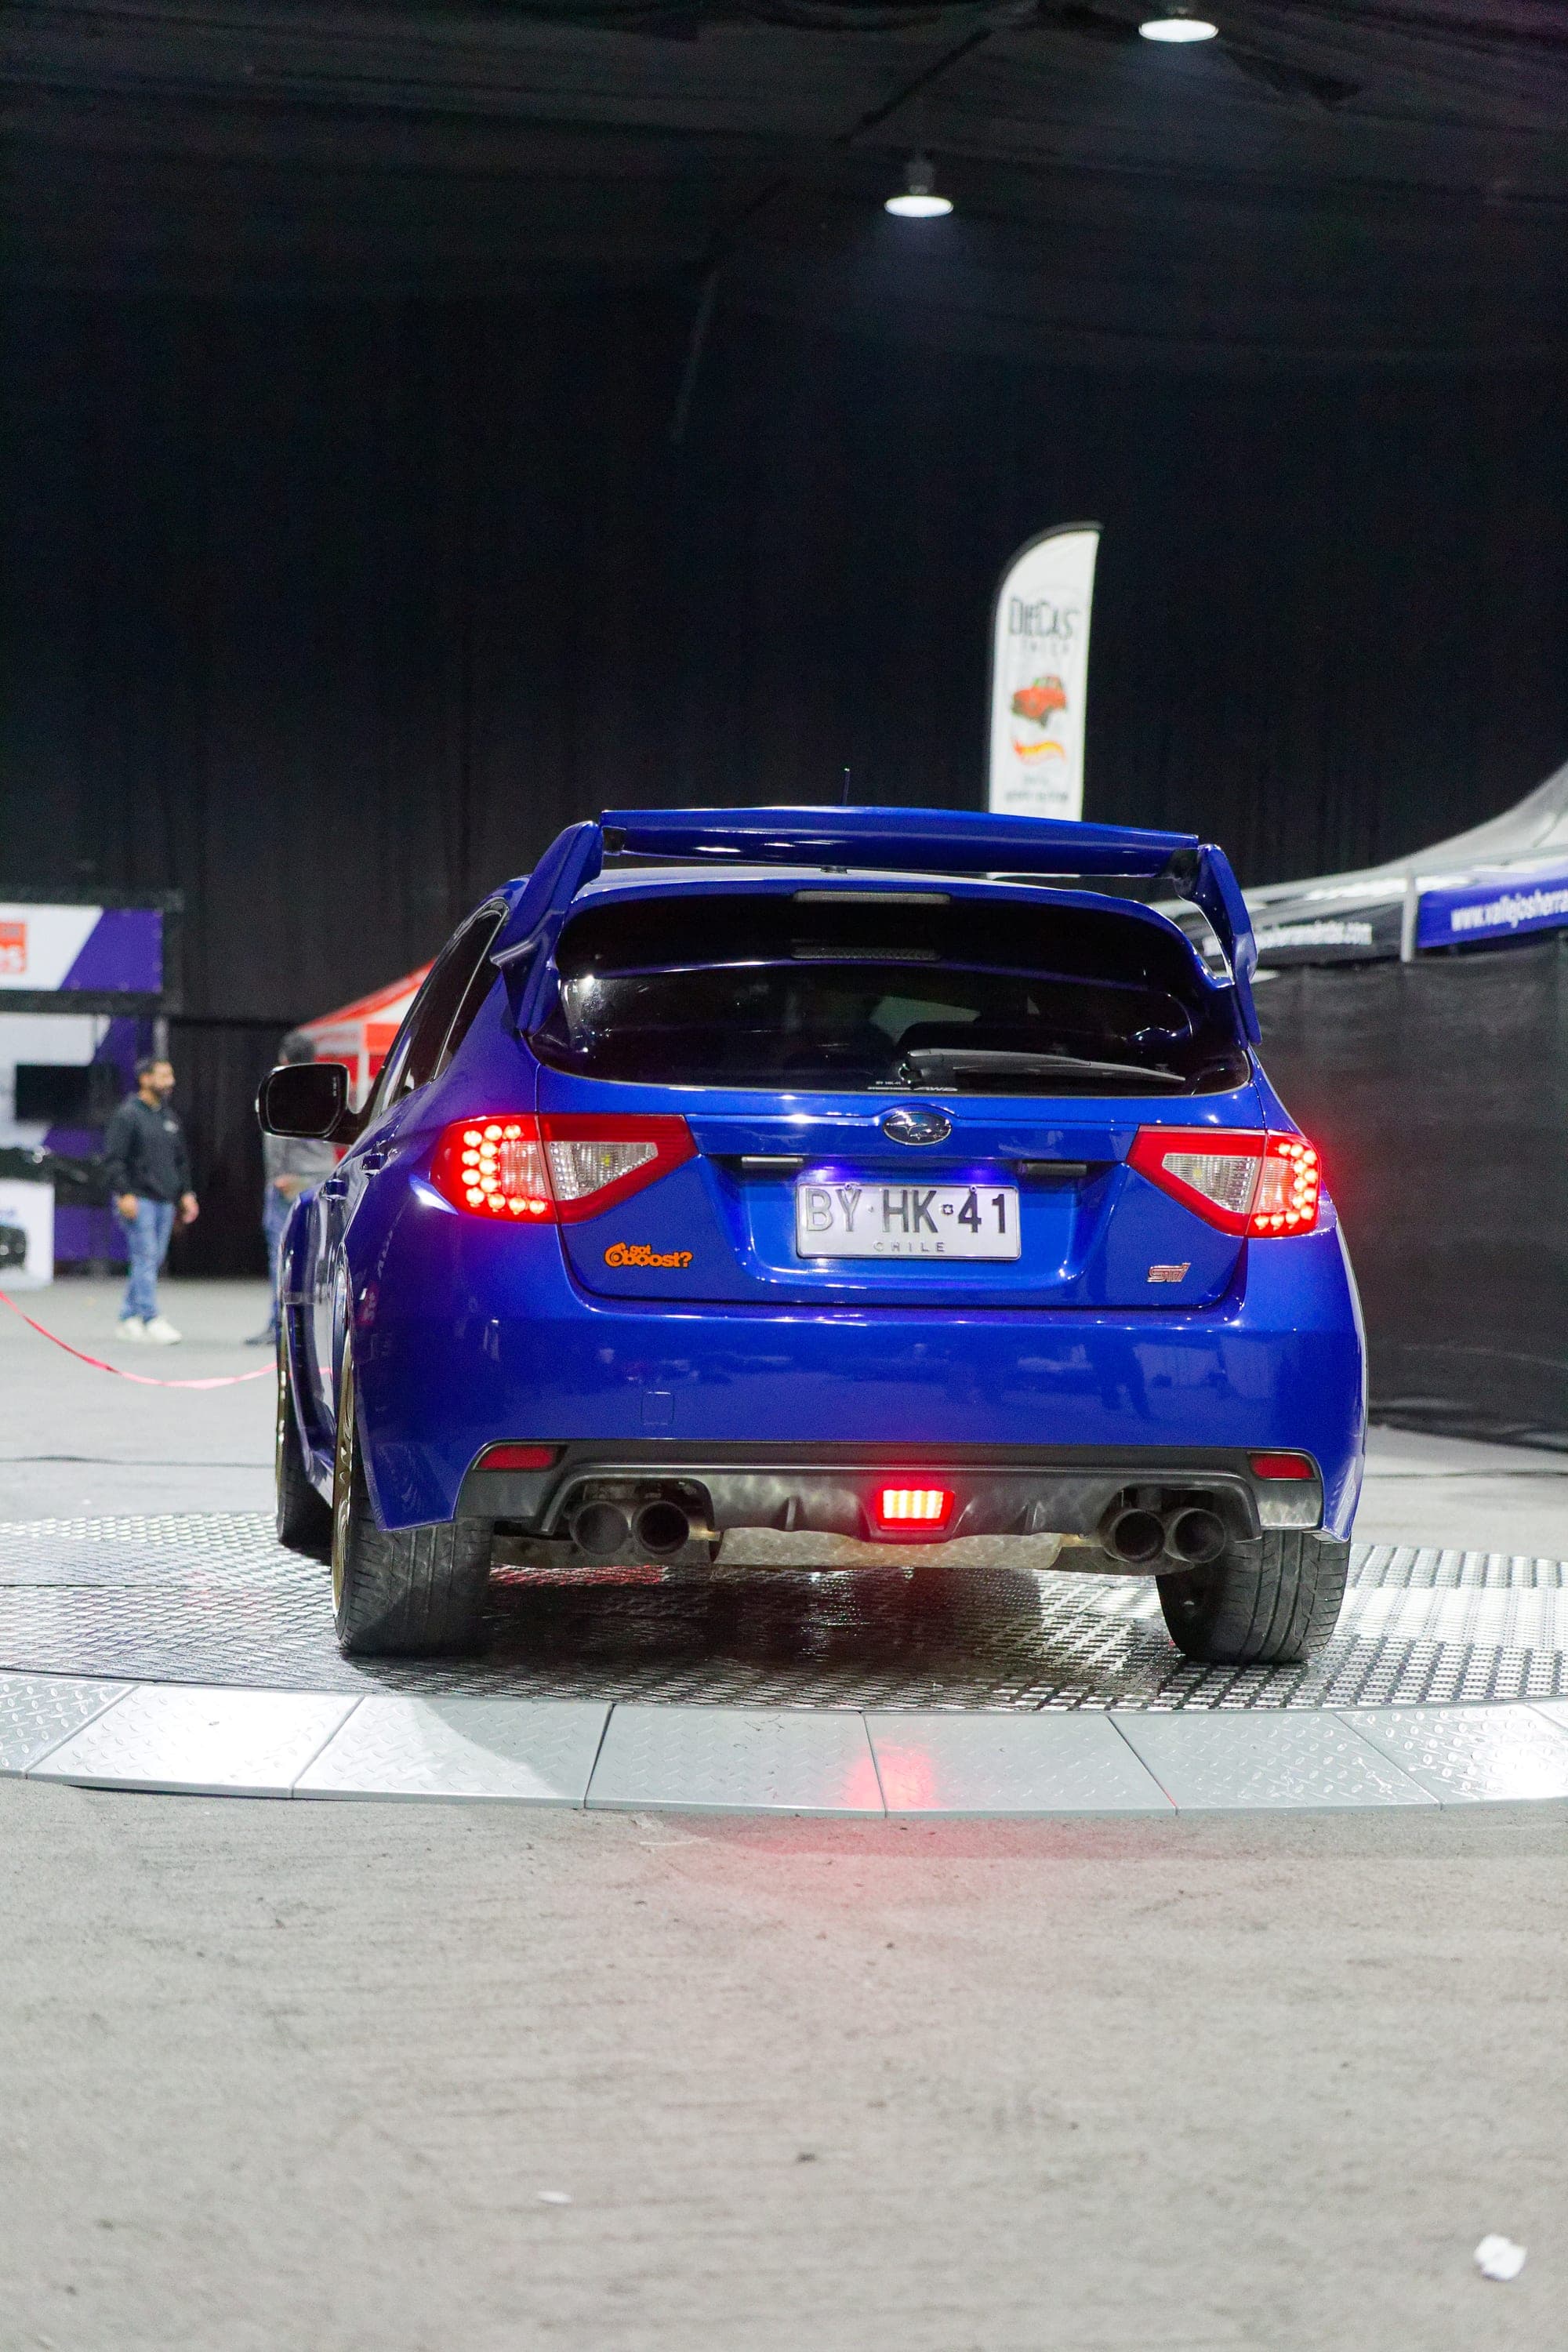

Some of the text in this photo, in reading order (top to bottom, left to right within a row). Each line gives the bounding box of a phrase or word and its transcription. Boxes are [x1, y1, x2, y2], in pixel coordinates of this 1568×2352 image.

[805, 1188, 1006, 1234] BY HK 41
[873, 1242, 946, 1253] CHILE
